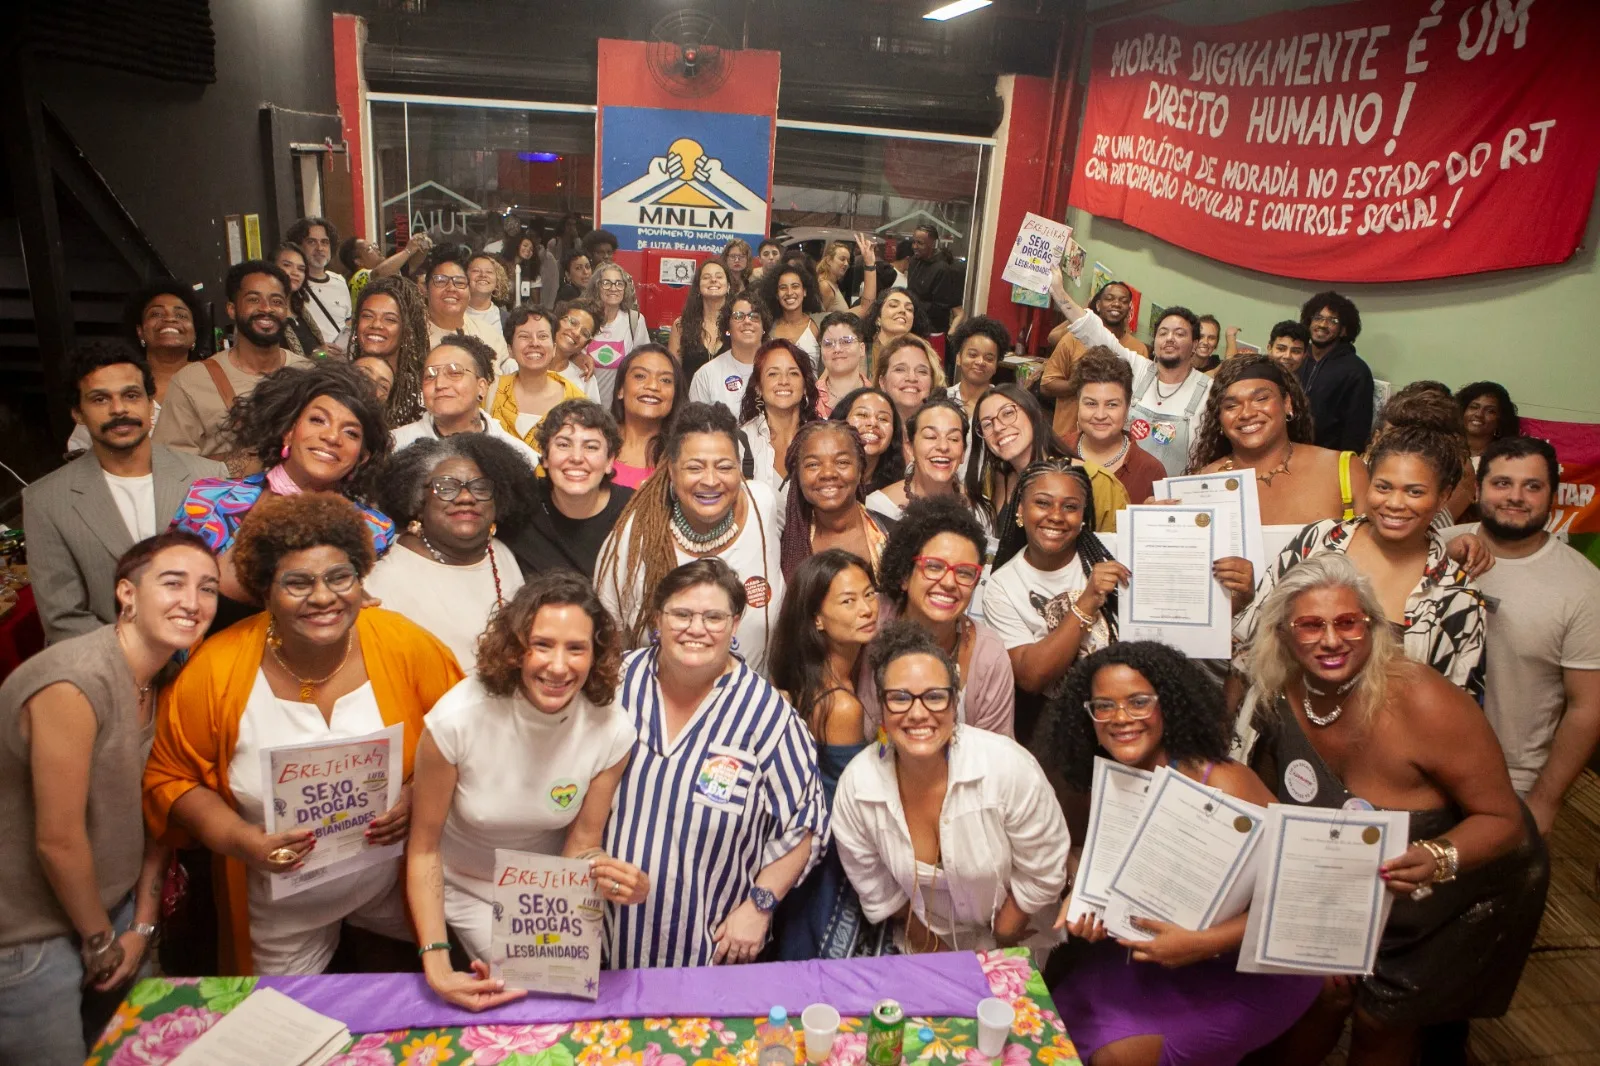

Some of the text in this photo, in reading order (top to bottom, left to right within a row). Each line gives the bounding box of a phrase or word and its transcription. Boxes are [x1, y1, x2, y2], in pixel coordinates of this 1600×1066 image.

[1110, 0, 1535, 86] MORAR DIGNAMENTE É UM
[1143, 81, 1229, 138] DIREITO
[1136, 136, 1193, 176] POLÍTICA
[1195, 154, 1218, 185] DE
[1306, 168, 1337, 199] NO
[1446, 143, 1491, 185] DO
[1500, 119, 1556, 169] RJ
[1085, 157, 1108, 183] COM
[1110, 162, 1178, 199] PARTCIPAÇÃO
[1180, 180, 1243, 223] POPULAR
[1245, 199, 1259, 226] E
[1262, 201, 1354, 236] CONTROLE
[638, 206, 734, 229] MNLM
[637, 228, 694, 239] MOVIMENTO
[637, 240, 647, 249] DE
[650, 241, 672, 250] LUTA
[674, 242, 696, 251] PELA
[1021, 245, 1053, 264] DROGAS
[278, 748, 383, 784] BREJEIRAS
[296, 792, 369, 824] DROGAS
[330, 813, 337, 823] E
[512, 917, 583, 937] DROGAS
[543, 933, 550, 944] E
[506, 943, 590, 960] LESBIANIDADES
